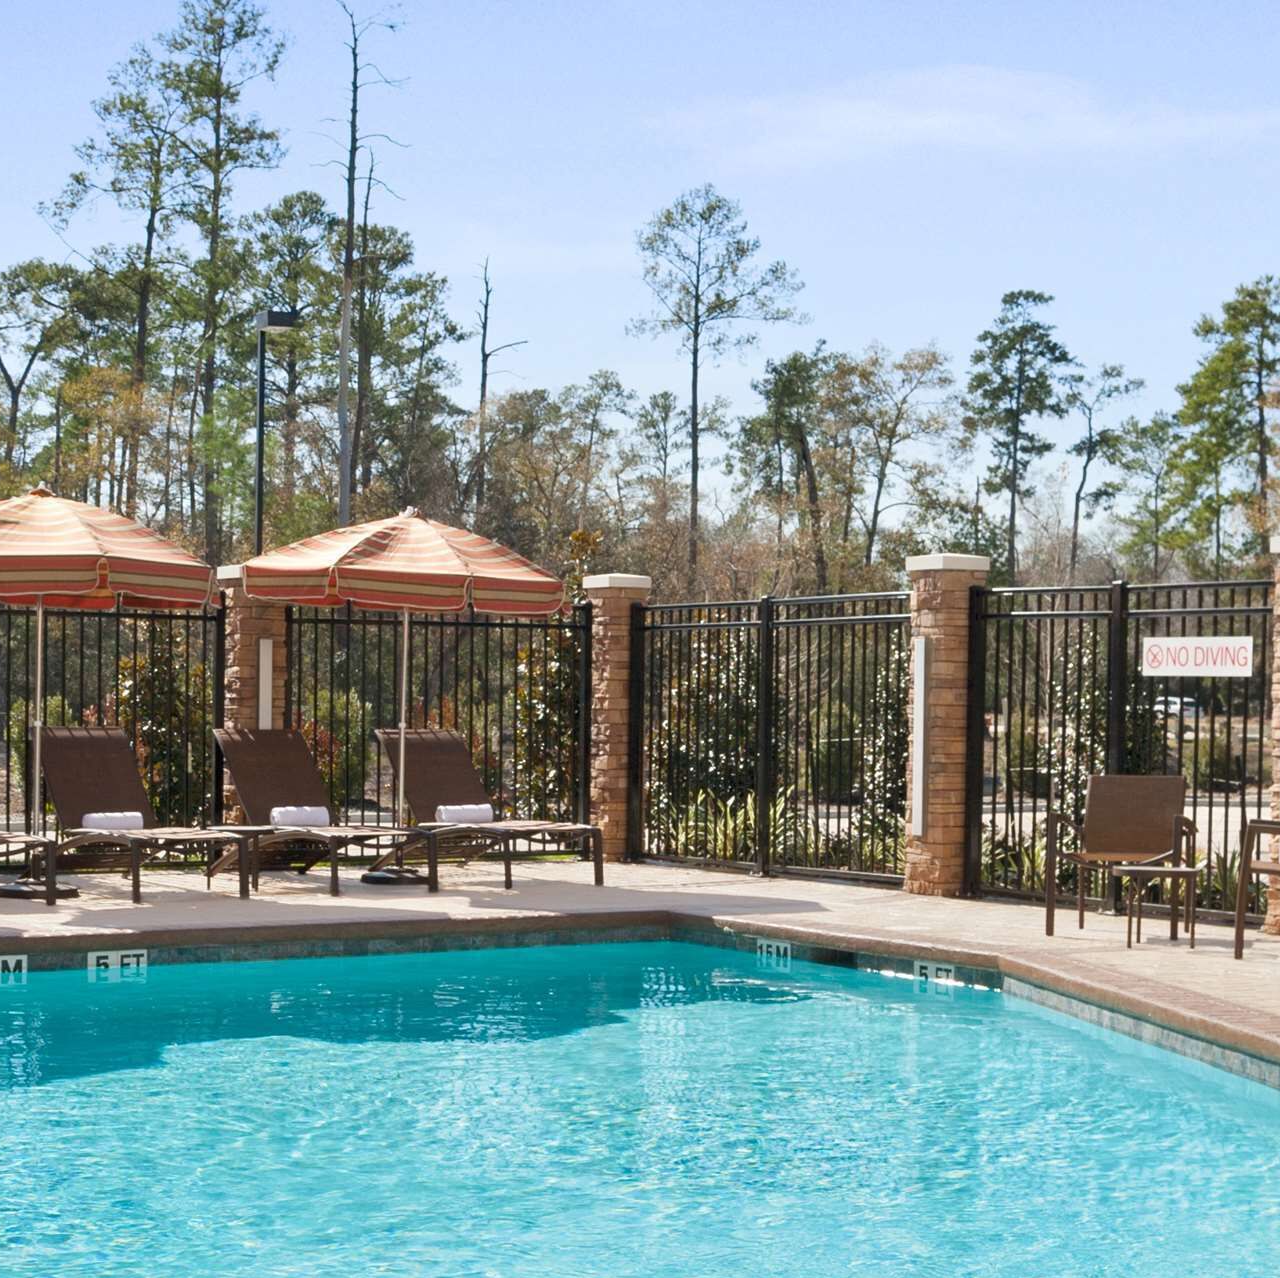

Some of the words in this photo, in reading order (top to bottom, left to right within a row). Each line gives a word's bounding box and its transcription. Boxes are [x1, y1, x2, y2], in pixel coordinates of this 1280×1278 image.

[1166, 646, 1189, 667] NO
[1194, 646, 1248, 667] DIVING
[120, 953, 144, 969] FT
